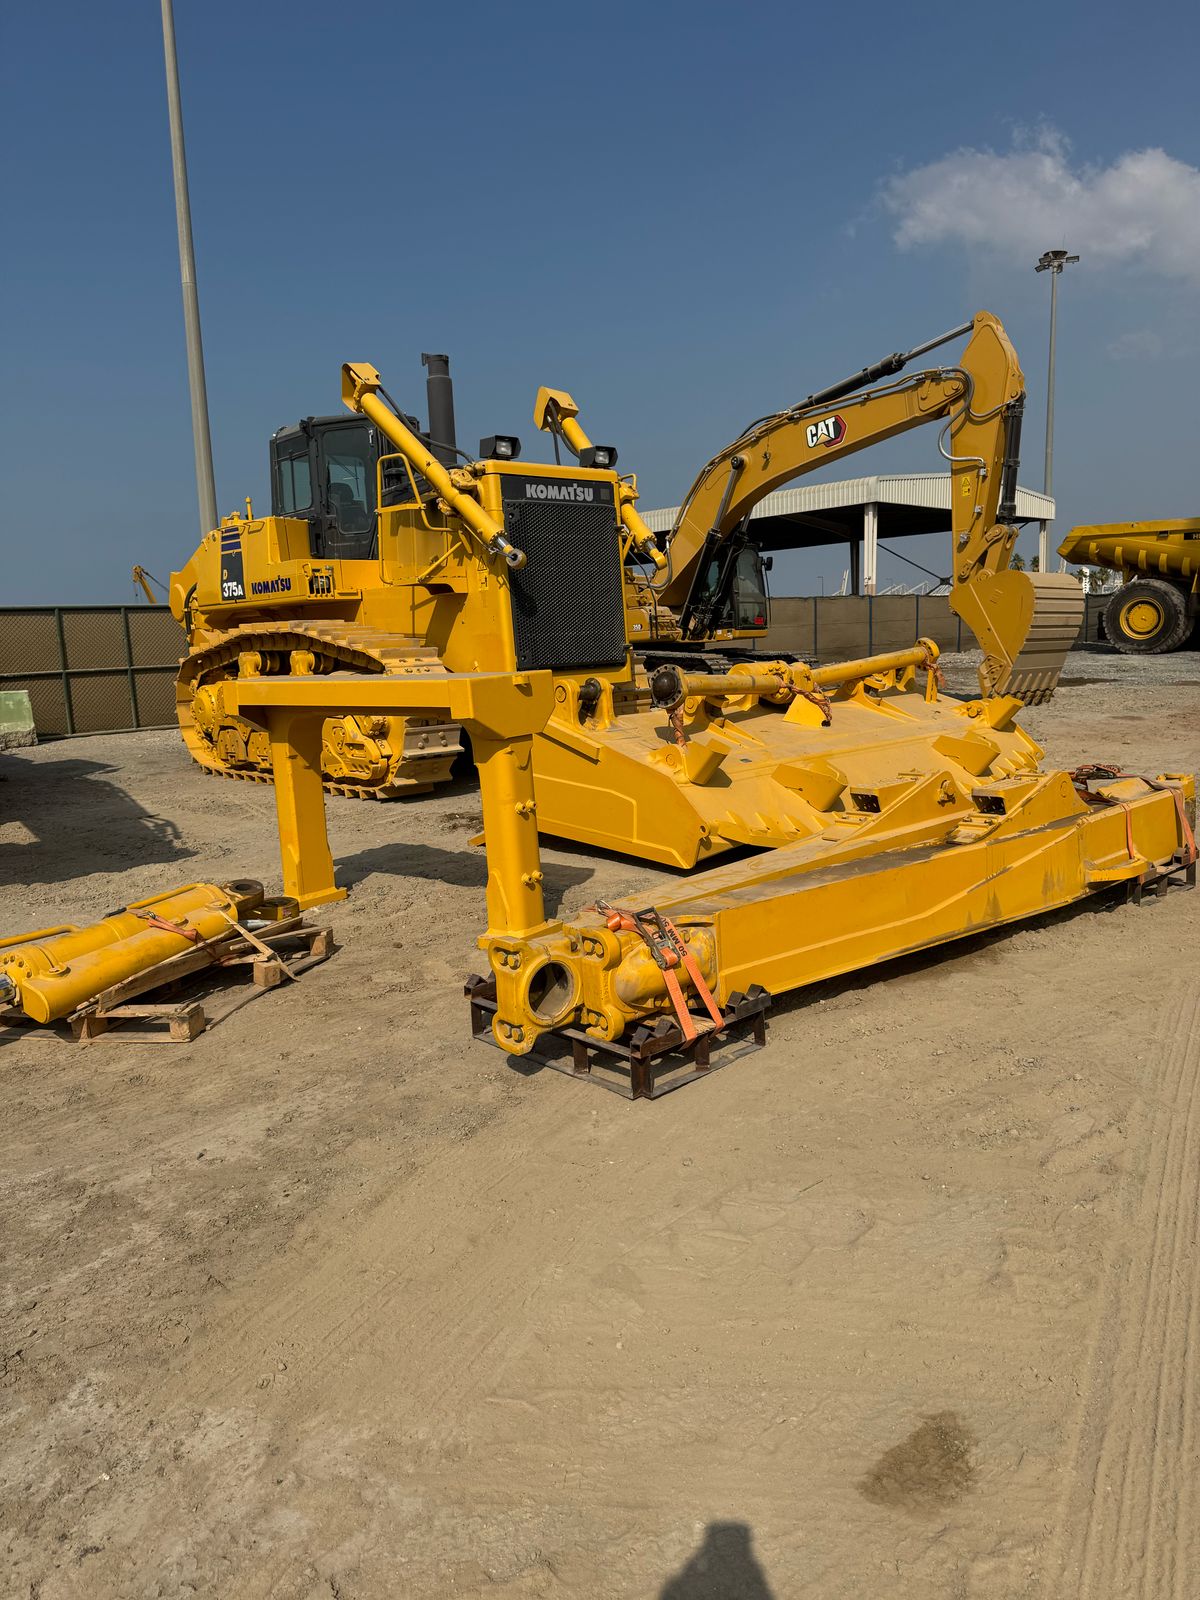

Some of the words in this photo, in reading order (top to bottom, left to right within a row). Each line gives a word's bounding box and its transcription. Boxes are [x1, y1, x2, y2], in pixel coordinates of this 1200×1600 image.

[806, 416, 836, 448] CAT
[525, 483, 594, 502] KOMATSU
[222, 569, 228, 580] D
[222, 581, 244, 598] 375A
[251, 575, 292, 595] KOMATSU
[667, 928, 680, 945] MM
[678, 945, 688, 957] 50
